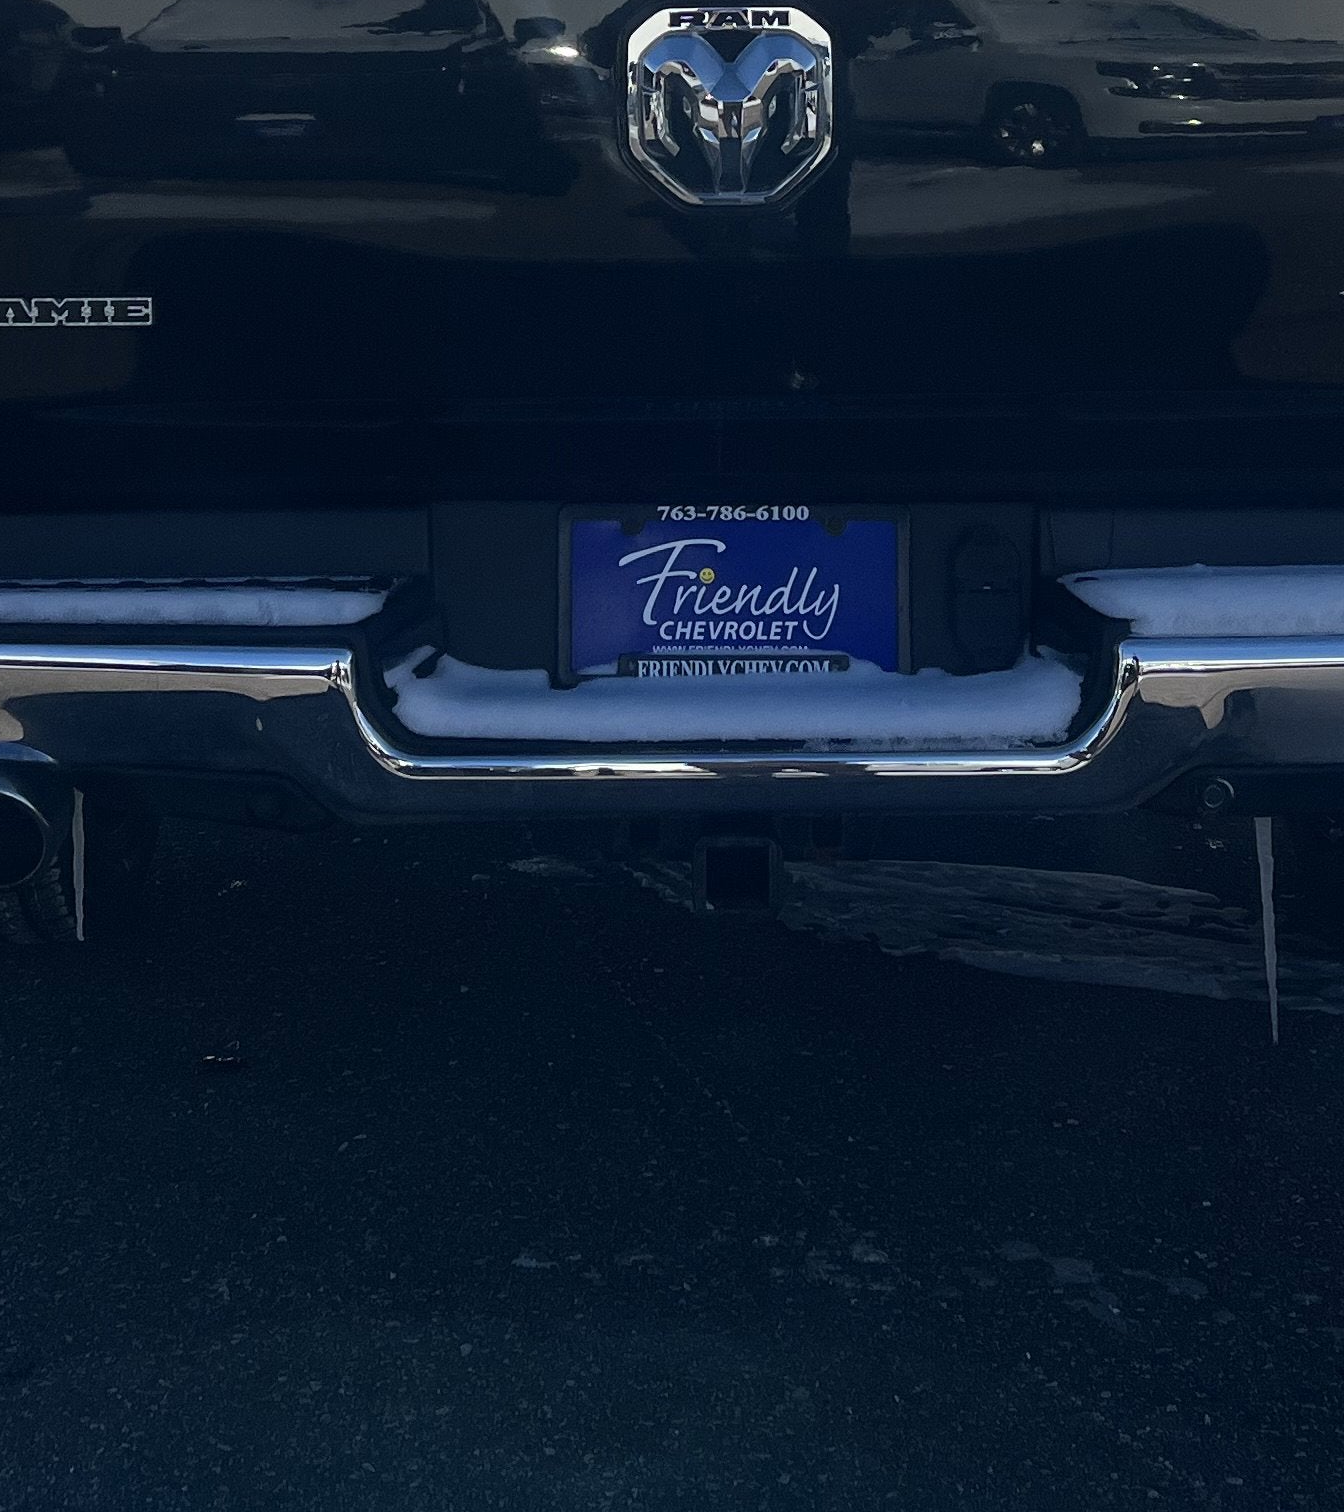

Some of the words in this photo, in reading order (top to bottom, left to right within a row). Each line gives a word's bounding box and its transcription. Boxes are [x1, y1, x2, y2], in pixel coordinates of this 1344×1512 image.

[668, 9, 791, 28] RAM
[657, 505, 810, 522] 763-786-6100
[618, 538, 840, 640] Friendly
[659, 620, 799, 641] CHEVROLET
